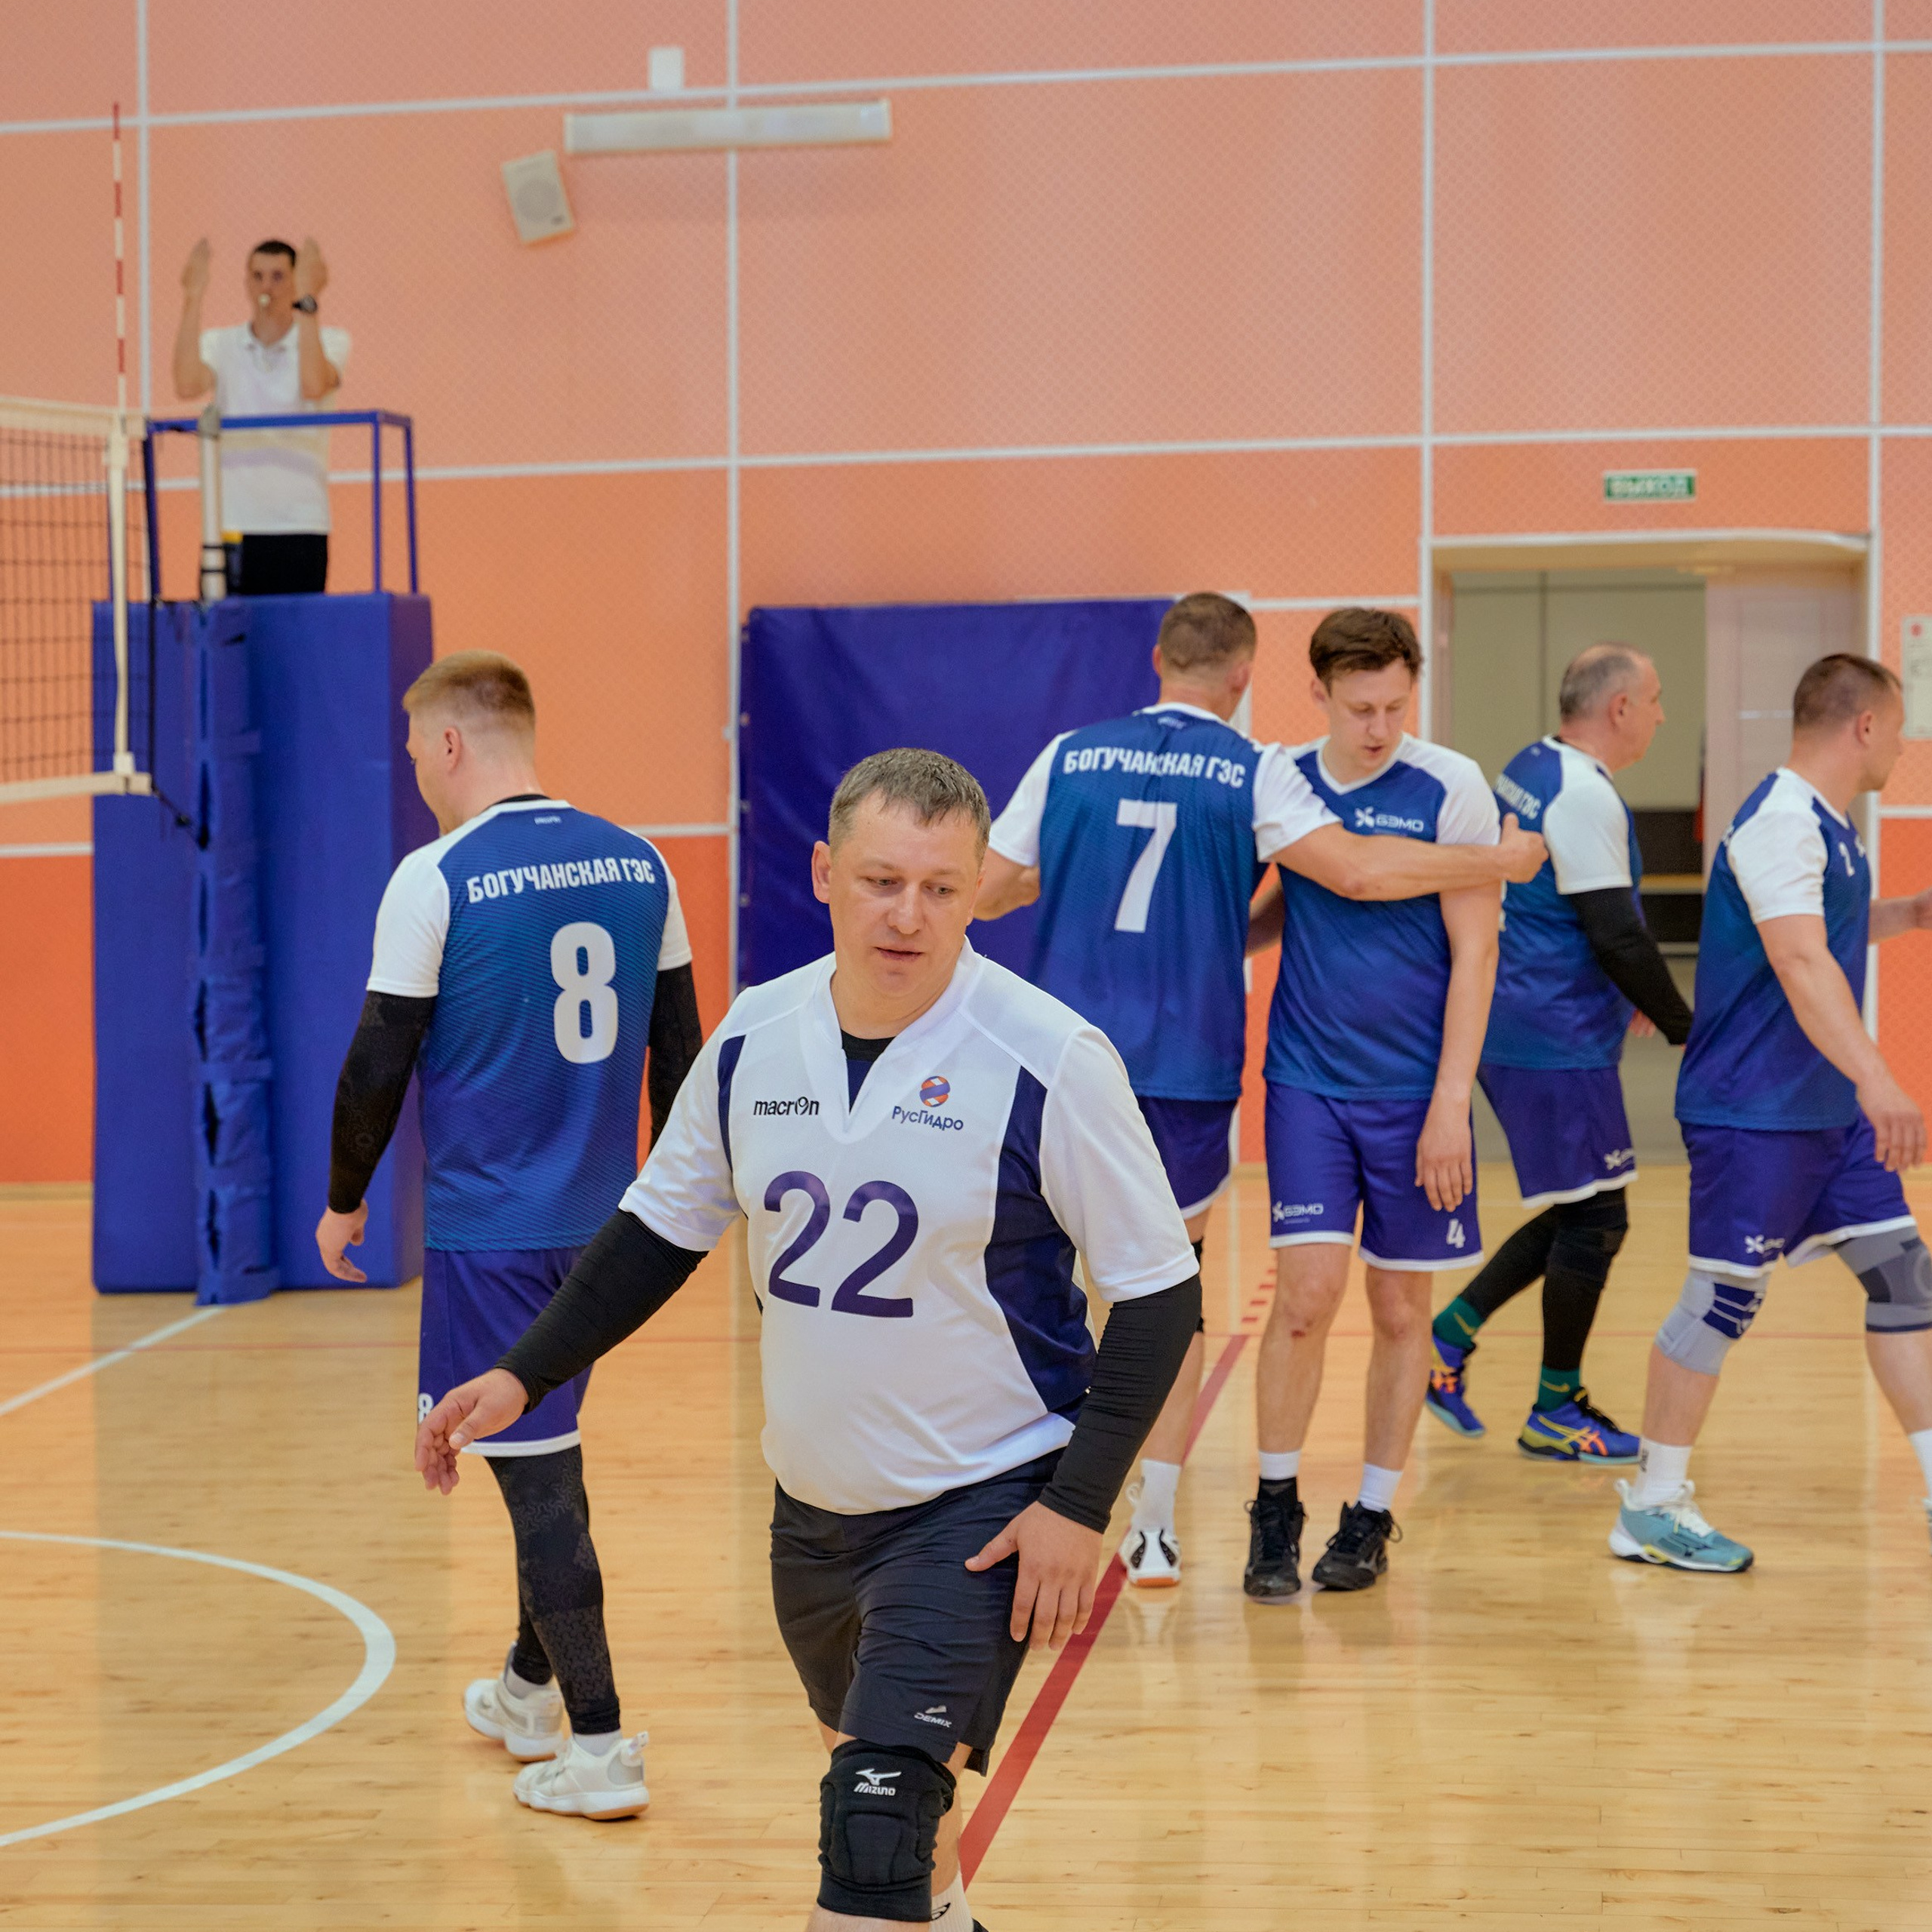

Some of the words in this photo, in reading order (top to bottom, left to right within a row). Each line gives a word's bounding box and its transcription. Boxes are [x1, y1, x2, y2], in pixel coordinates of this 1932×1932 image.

[1205, 755, 1245, 788] ГЭС
[466, 857, 621, 903] БОГУЧАНСКАЯ
[620, 858, 655, 884] ГЭС
[1115, 798, 1177, 933] 7
[550, 921, 618, 1064] 8
[753, 1097, 820, 1115] macron
[891, 1106, 964, 1131] РусГидро
[764, 1171, 918, 1318] 22
[1446, 1218, 1466, 1248] 4
[418, 1393, 434, 1424] 8
[914, 1712, 952, 1727] DEMIX
